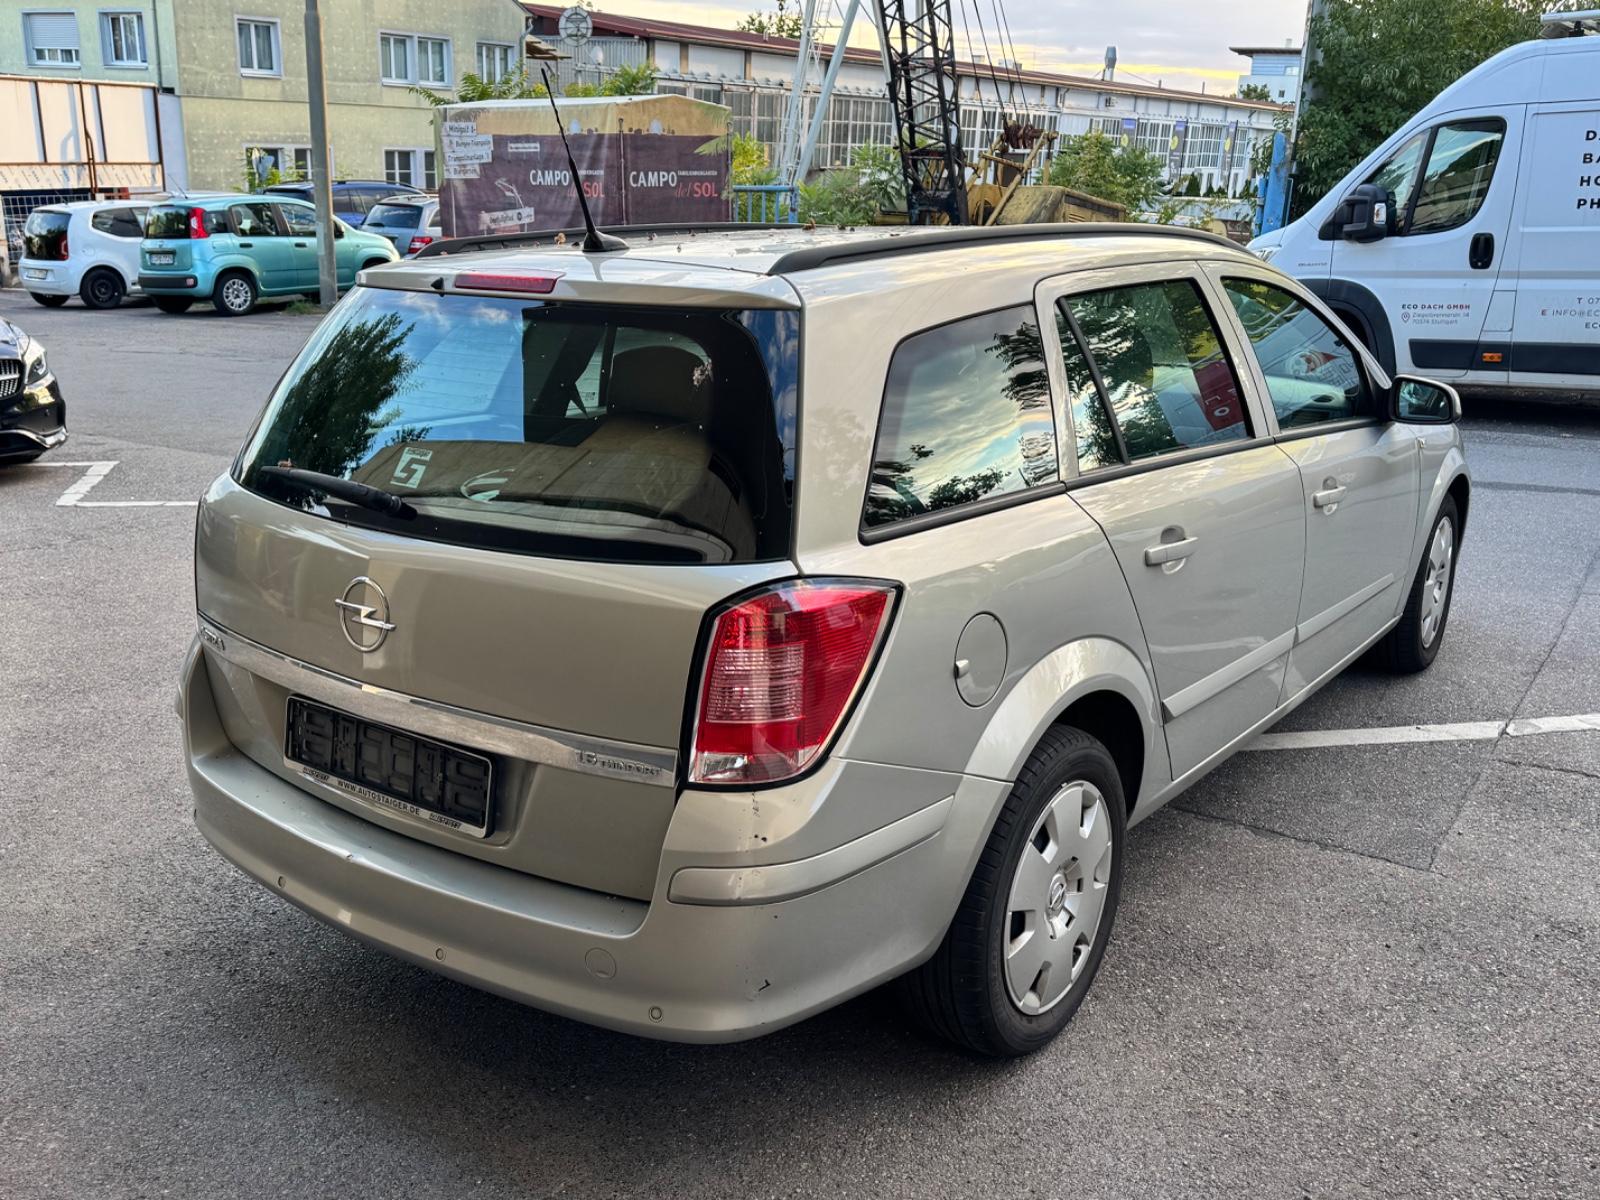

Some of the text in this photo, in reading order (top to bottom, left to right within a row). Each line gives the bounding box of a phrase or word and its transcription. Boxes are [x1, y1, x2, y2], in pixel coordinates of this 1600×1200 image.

[1585, 130, 1600, 141] D
[529, 169, 569, 186] CAMPO
[629, 170, 677, 187] CAMPO
[582, 181, 605, 198] SOL
[693, 181, 719, 198] SOL
[1541, 308, 1547, 316] E
[1431, 318, 1458, 326] Stuttgart
[337, 779, 420, 816] WWW.AUTOSTAIGER.DE
